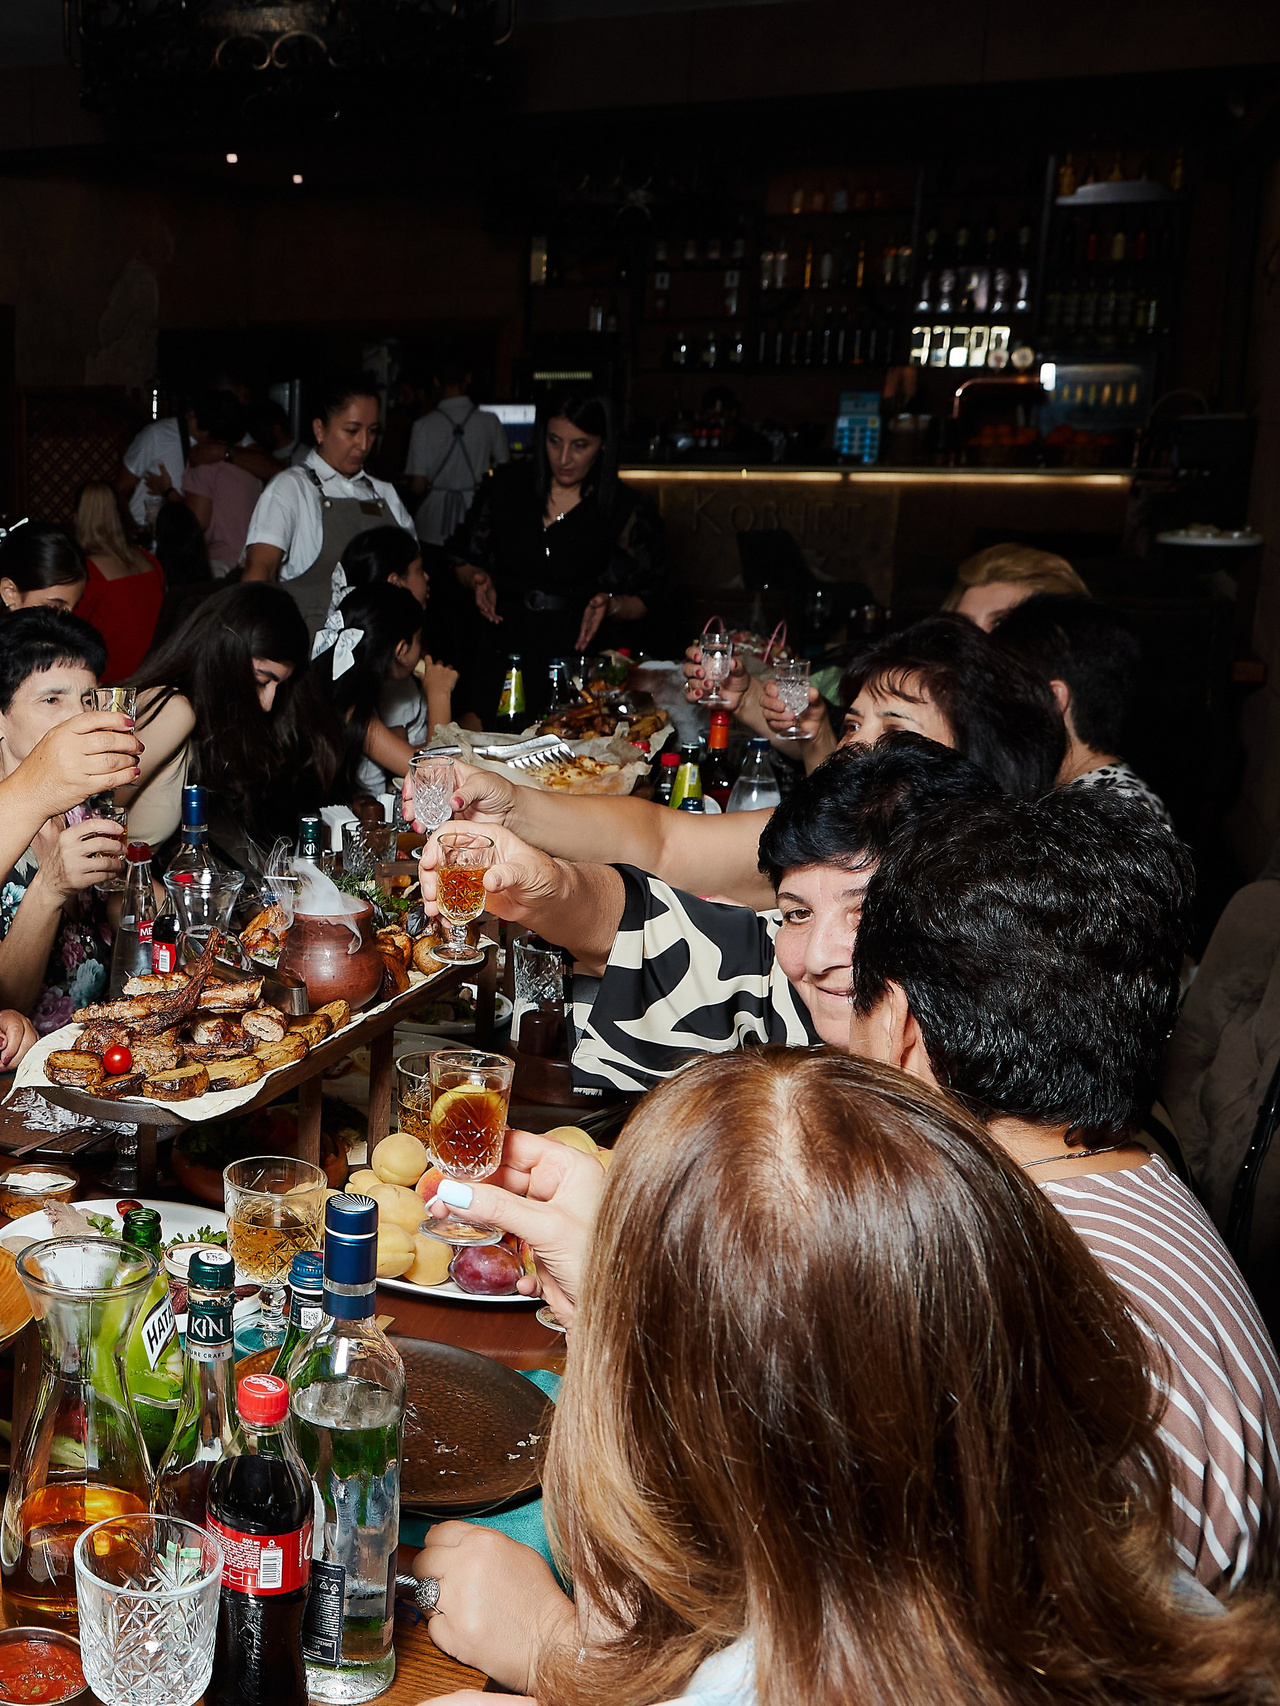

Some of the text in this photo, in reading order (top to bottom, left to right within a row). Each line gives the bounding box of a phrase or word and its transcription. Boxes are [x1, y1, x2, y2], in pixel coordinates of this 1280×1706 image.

[146, 1300, 175, 1354] НАТА
[191, 1314, 226, 1339] KIN
[203, 1351, 226, 1359] CRAFT
